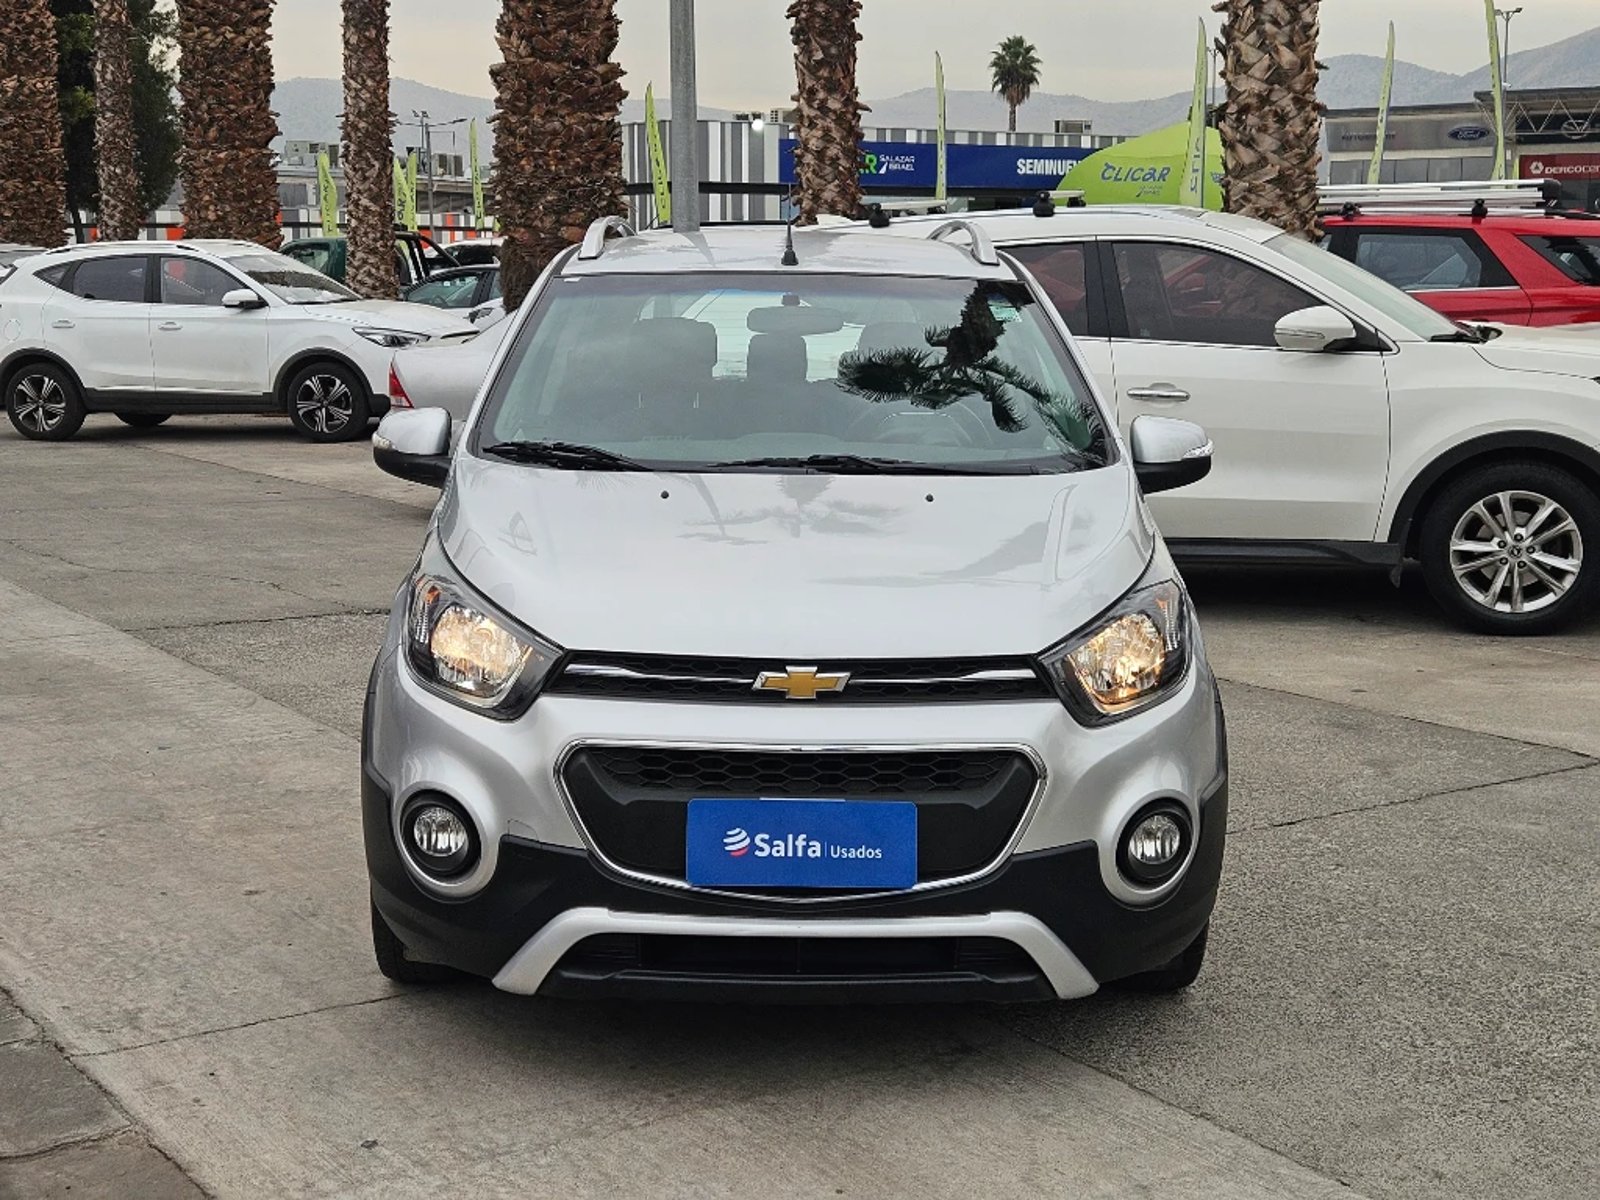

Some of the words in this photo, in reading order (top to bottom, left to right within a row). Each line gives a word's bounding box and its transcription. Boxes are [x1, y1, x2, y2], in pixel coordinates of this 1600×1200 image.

[879, 154, 915, 163] SALAZAR
[754, 833, 821, 858] Salfa
[830, 845, 882, 859] Usados
